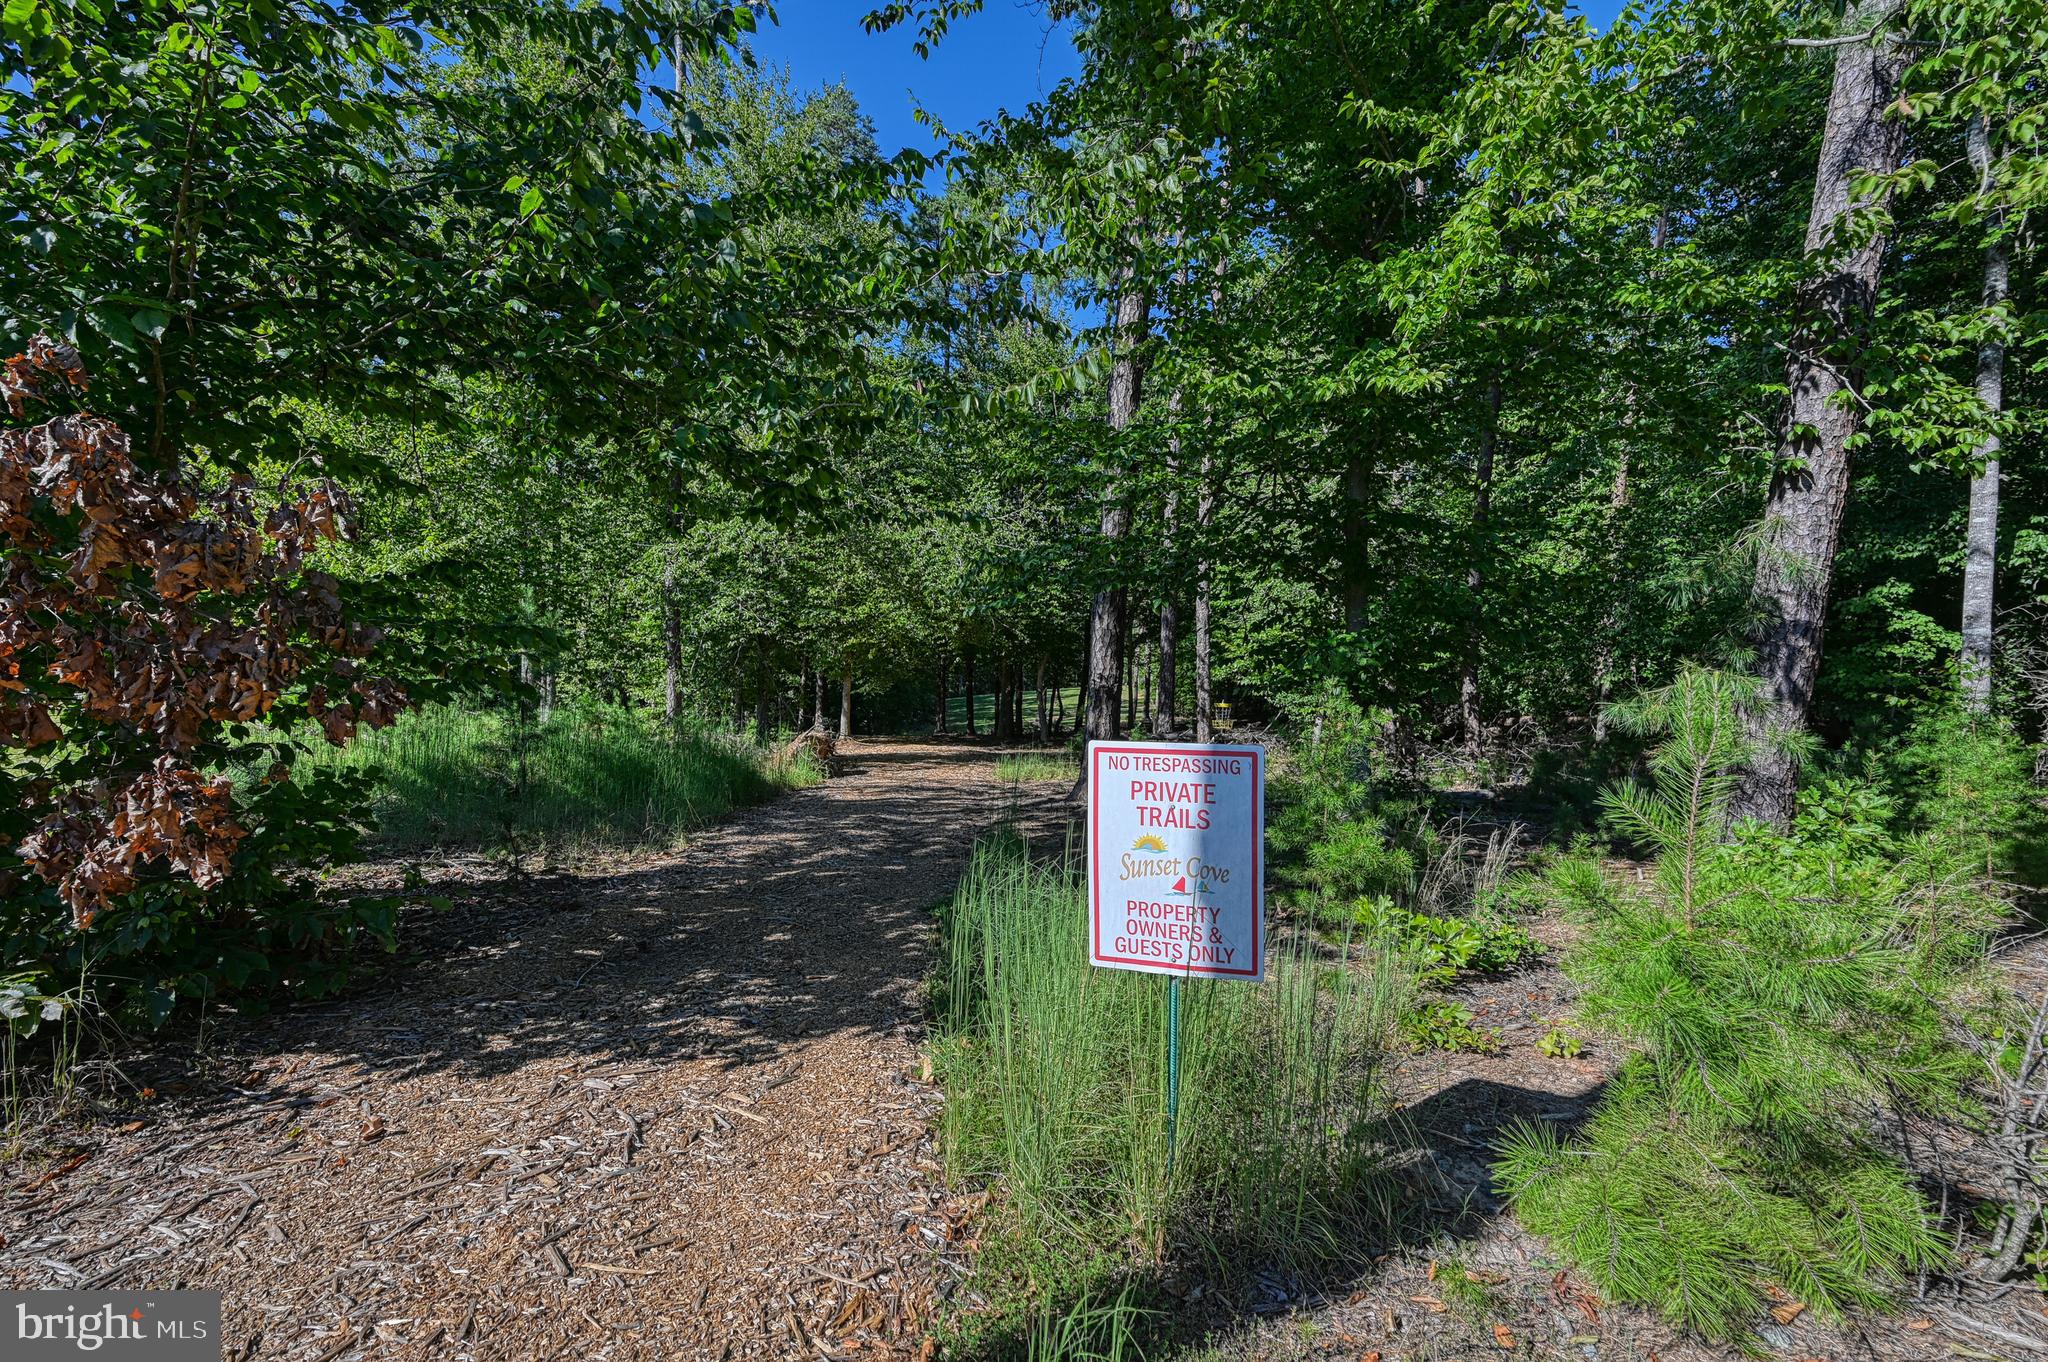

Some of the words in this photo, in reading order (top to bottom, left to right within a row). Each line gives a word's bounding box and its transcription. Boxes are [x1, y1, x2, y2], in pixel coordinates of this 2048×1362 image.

[1108, 755, 1130, 771] NO
[1133, 757, 1241, 775] TRESPASSING
[1130, 780, 1217, 804] PRIVATE
[1136, 806, 1211, 830] TRAILS
[1119, 852, 1181, 881] Sunset
[1186, 856, 1230, 884] Cove
[1127, 900, 1221, 924] PROPERTY
[1126, 919, 1203, 943] OWNERS
[1209, 927, 1223, 944] &
[1115, 937, 1183, 960] GUESTS
[1189, 944, 1235, 964] ONLY
